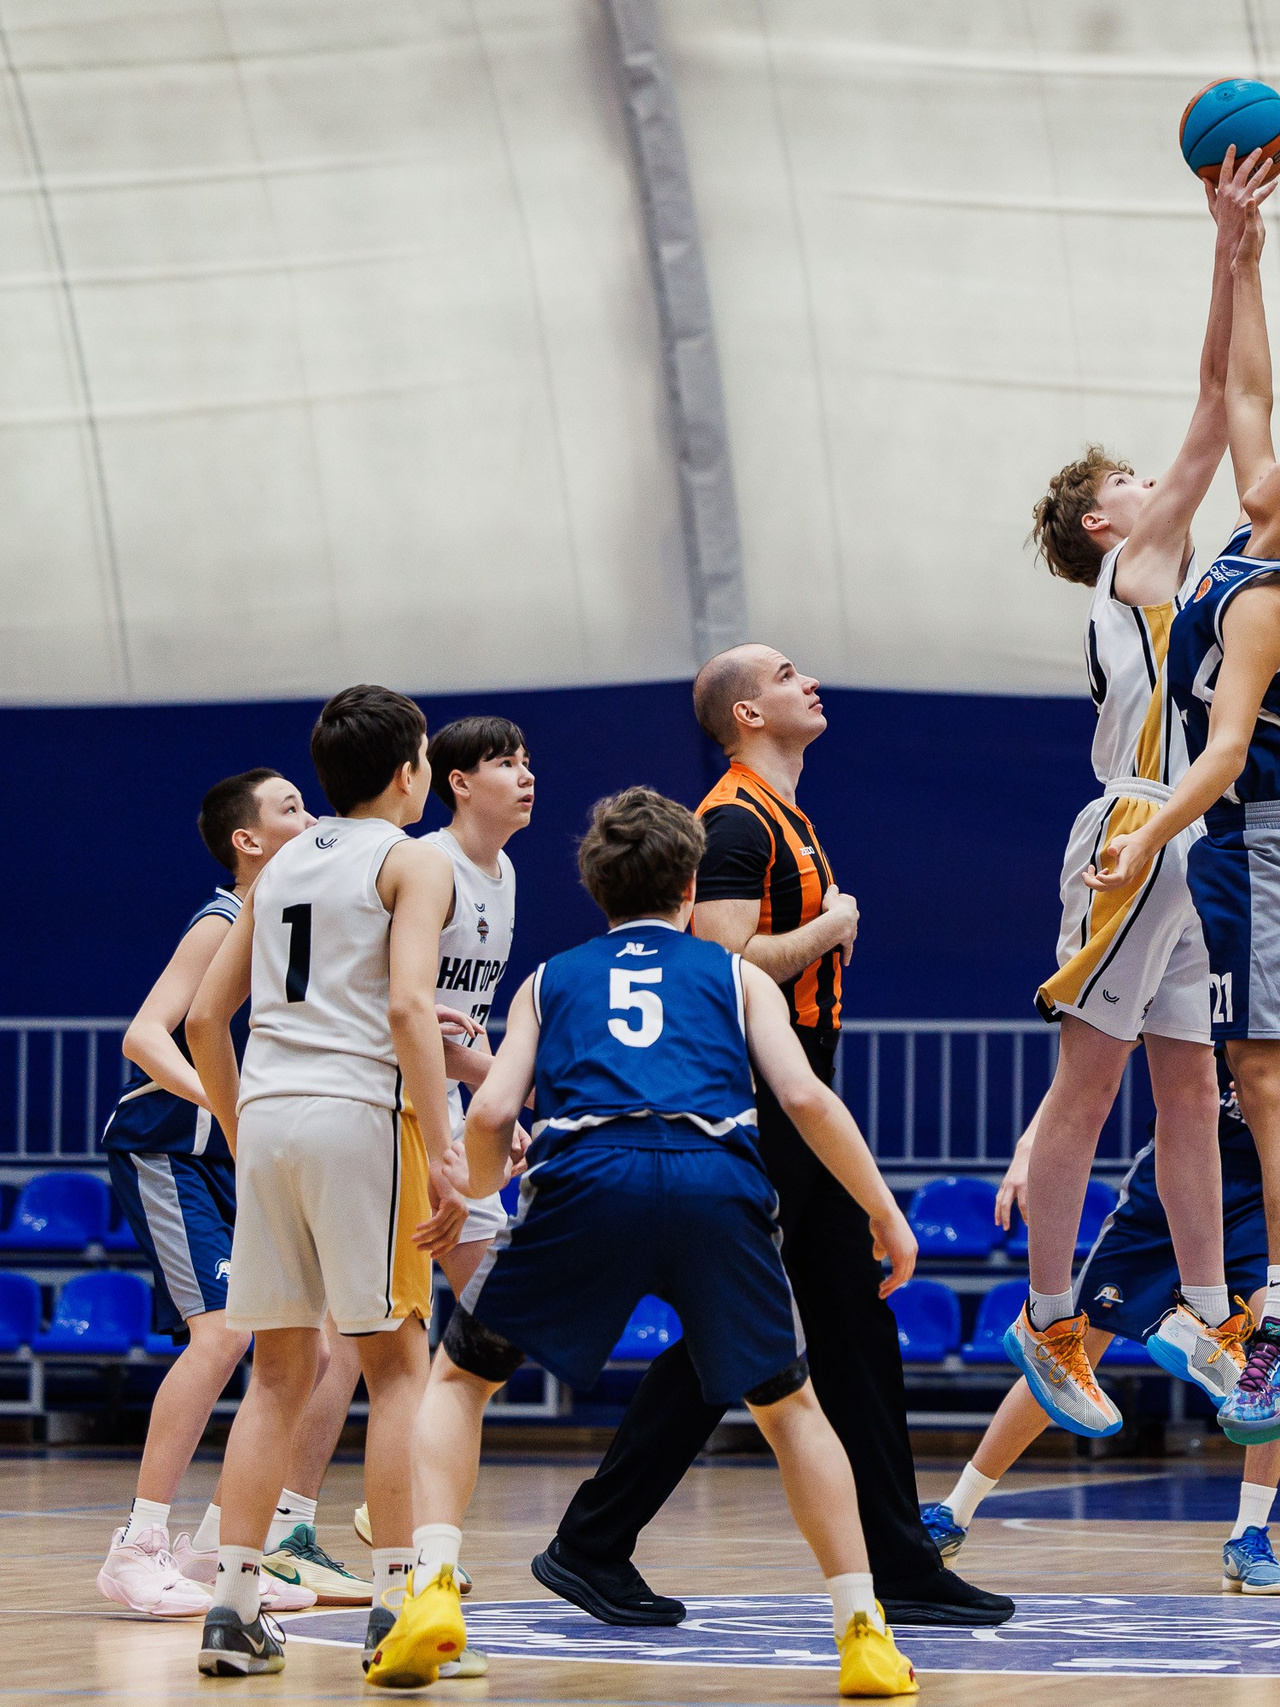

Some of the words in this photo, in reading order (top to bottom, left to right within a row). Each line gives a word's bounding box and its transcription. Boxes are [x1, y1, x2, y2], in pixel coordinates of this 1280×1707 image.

[281, 903, 312, 1003] 1
[436, 956, 508, 992] НАГОР
[607, 967, 664, 1048] 5
[1209, 972, 1233, 1024] 21
